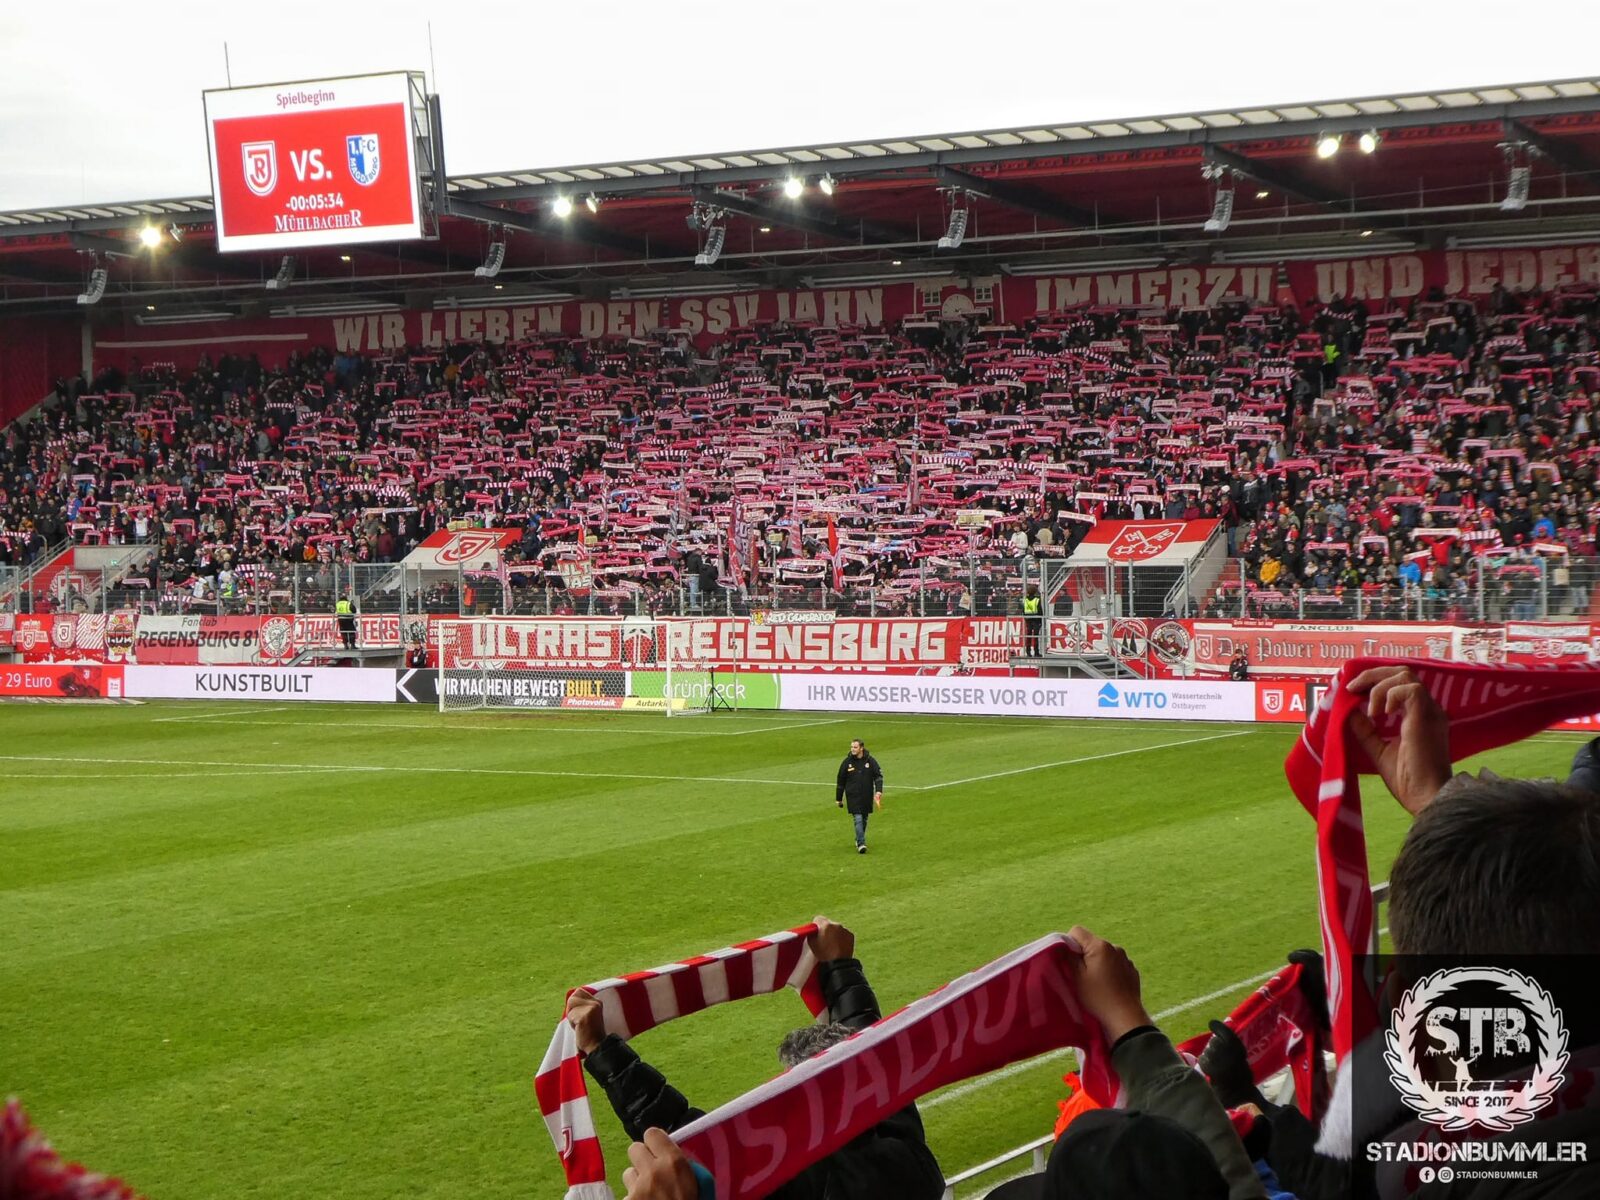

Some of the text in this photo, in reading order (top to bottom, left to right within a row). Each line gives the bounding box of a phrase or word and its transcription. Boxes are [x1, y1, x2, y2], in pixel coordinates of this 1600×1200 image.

[276, 90, 335, 108] Spielbeginn
[290, 149, 333, 181] VS.
[333, 312, 406, 352] WIR
[421, 305, 563, 349] LIEBEN
[580, 301, 661, 338] DEN
[680, 294, 759, 335] SSV
[1034, 267, 1273, 315] IMMERZU
[1315, 256, 1424, 304] UND
[182, 617, 217, 627] Fanclub
[1289, 624, 1354, 632] FANCLUB
[138, 631, 240, 648] REGENSBURG
[243, 630, 259, 647] 81
[473, 622, 947, 661] ULTRAS REGENSBURG
[968, 621, 1021, 645] JAHN
[1256, 636, 1314, 661] Power
[1320, 640, 1356, 659] vom
[6, 673, 21, 688] 29
[25, 673, 52, 688] Euro
[196, 673, 313, 693] KUNSTBUILT
[434, 678, 458, 695] WIR
[460, 679, 512, 696] MACHEN
[807, 685, 1068, 706] IHR WASSER-WISSER VOR ORT
[1124, 692, 1167, 709] WTO
[1171, 691, 1222, 701] Wassertechnik
[1171, 702, 1206, 711] Ostbayern
